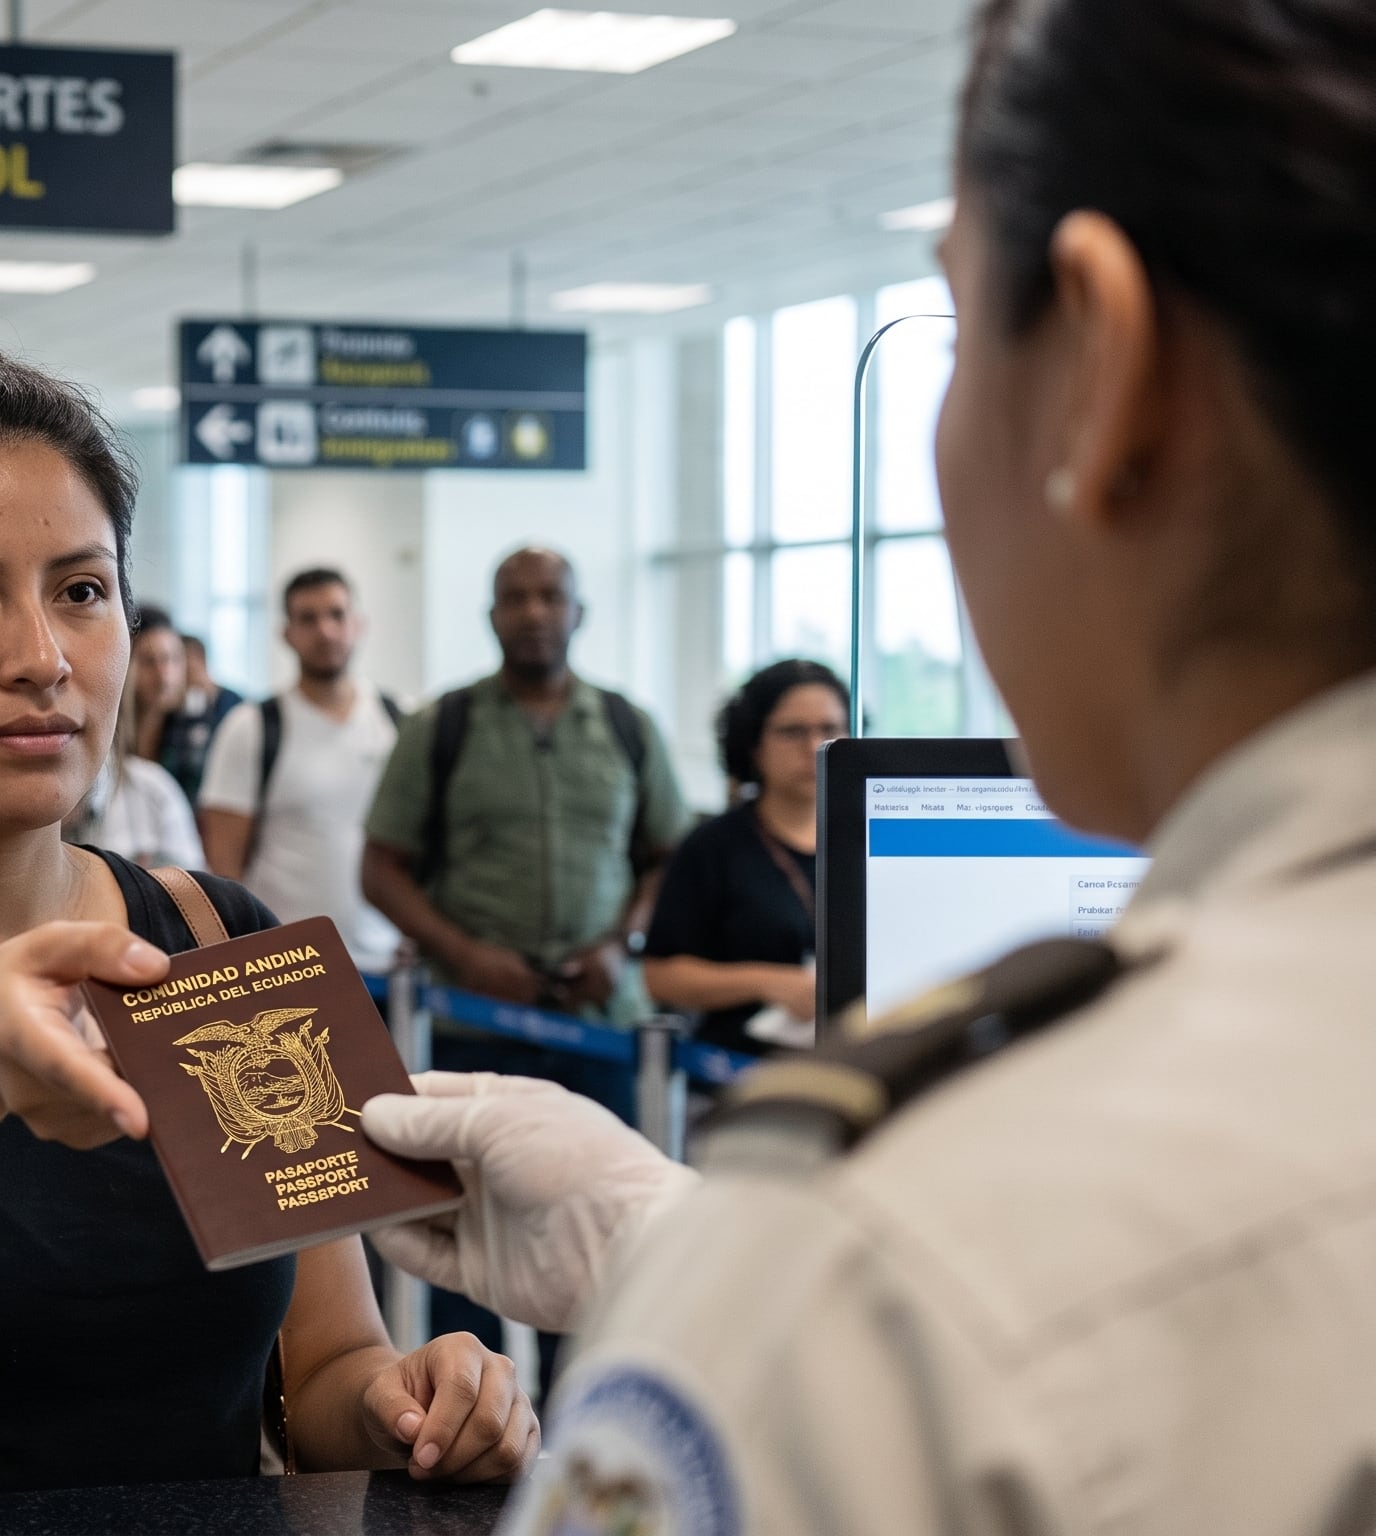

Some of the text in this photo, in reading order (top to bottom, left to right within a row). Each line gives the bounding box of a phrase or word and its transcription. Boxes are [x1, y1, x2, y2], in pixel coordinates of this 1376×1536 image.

[122, 945, 321, 1007] COMUNIDAD ANDINA
[131, 964, 327, 1024] REPÚBLICA DEL ECUADOR
[264, 1150, 359, 1184] PASAPORTE
